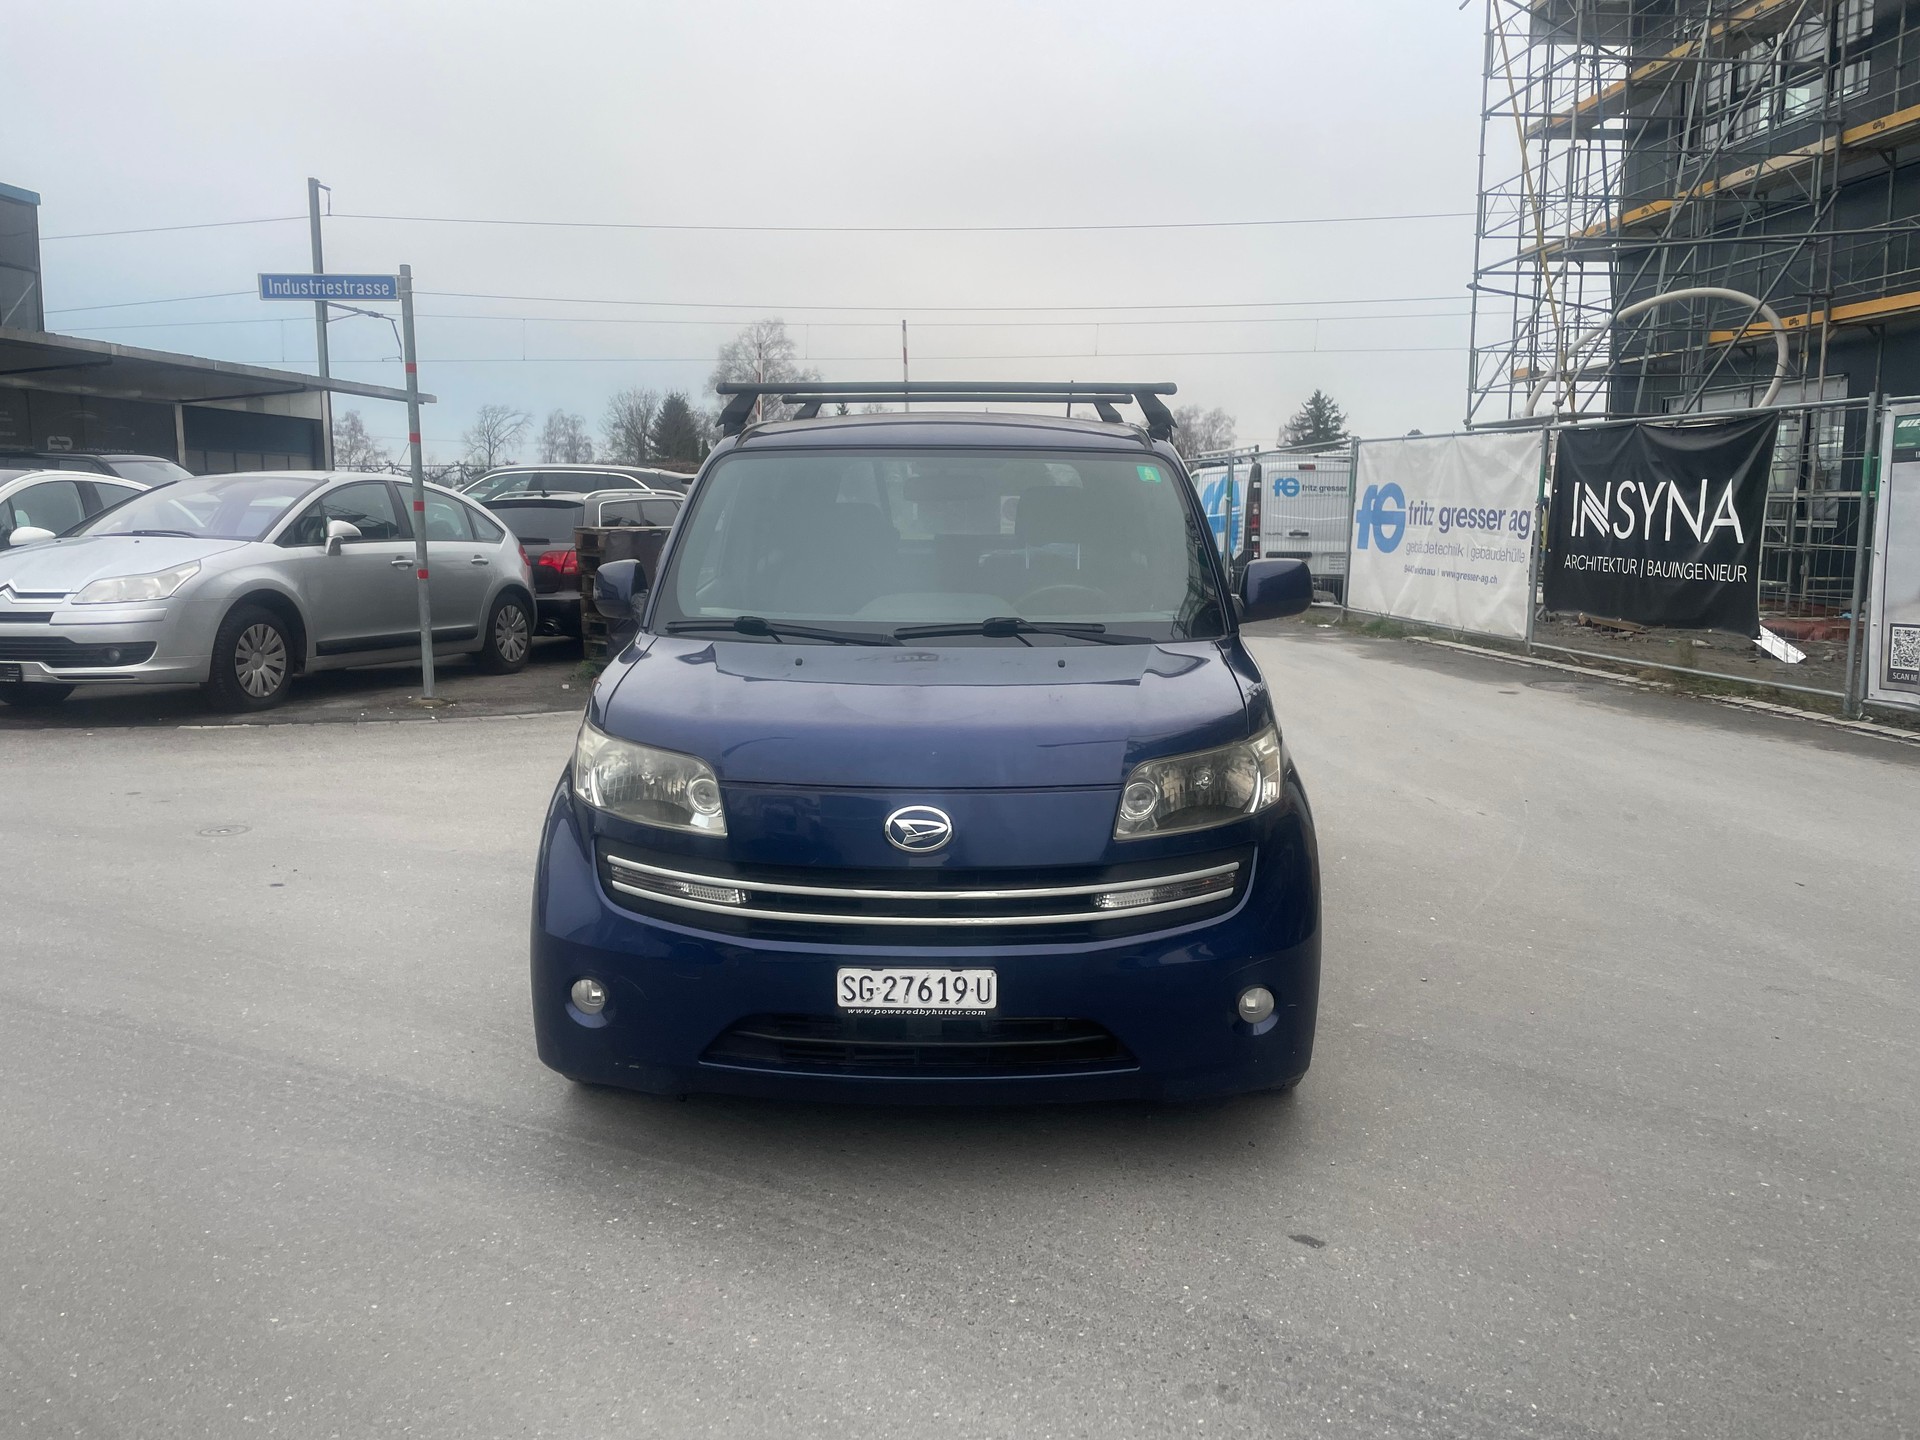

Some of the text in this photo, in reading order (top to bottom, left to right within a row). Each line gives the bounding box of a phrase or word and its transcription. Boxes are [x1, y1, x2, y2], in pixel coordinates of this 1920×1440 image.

[268, 278, 390, 296] Industriestrasse
[1301, 484, 1347, 494] fritz gresser
[1408, 500, 1532, 540] fritz gresser ag
[1563, 554, 1748, 583] ARCHITEKTUR BAUINGENIEUR
[1892, 672, 1910, 681] SCAN
[847, 1007, 987, 1016] www.poweredbyhutter.com
